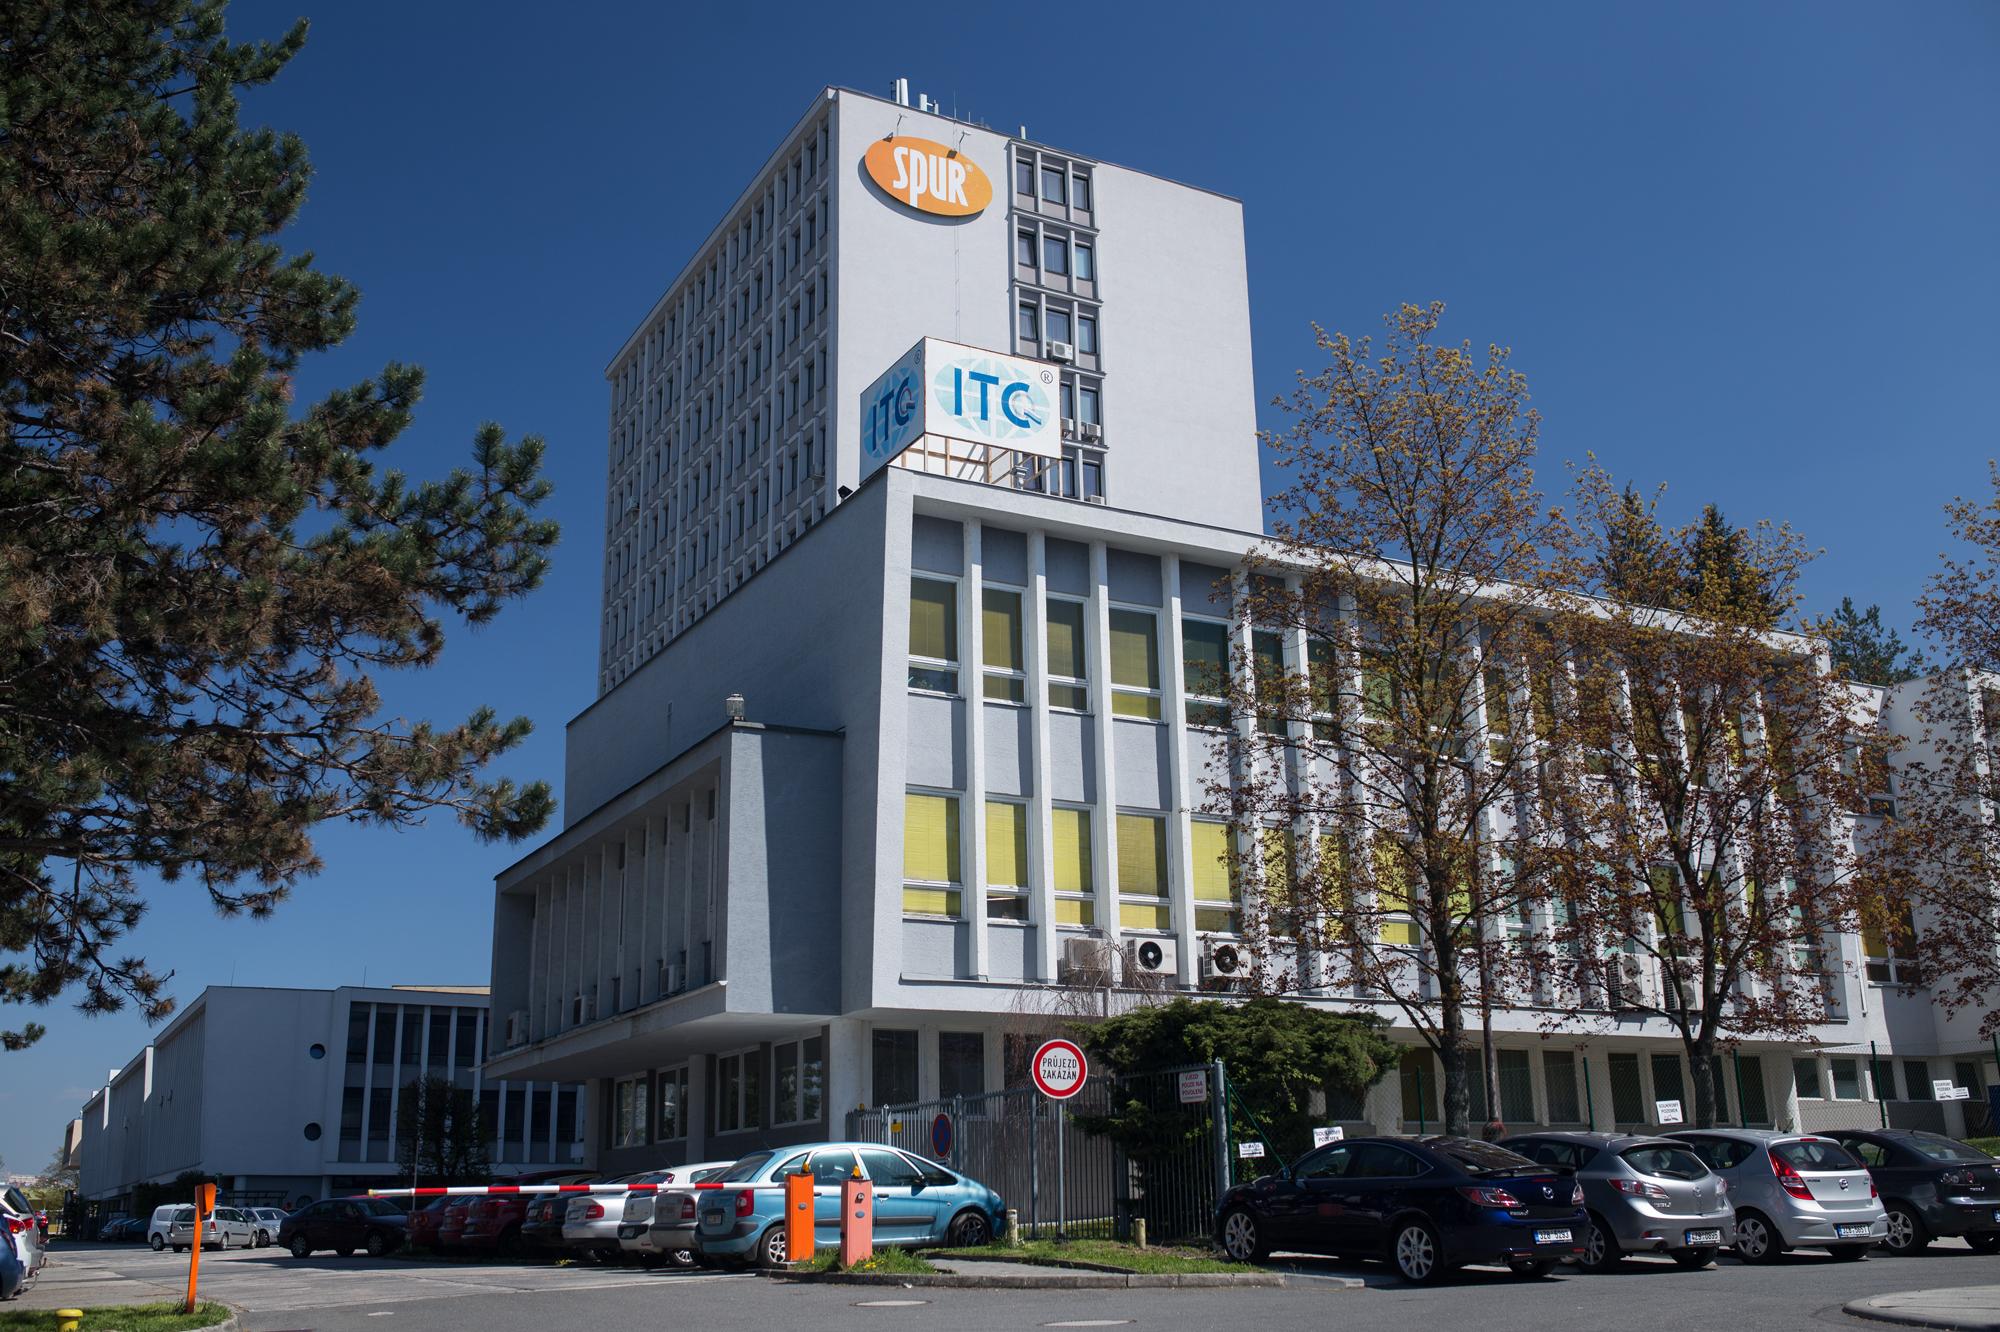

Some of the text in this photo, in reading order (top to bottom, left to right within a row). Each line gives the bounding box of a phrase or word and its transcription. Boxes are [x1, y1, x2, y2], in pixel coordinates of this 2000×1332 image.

[871, 376, 916, 452] ITC
[954, 367, 1042, 429] ITC
[1042, 1055, 1077, 1069] PRŮJEZD
[1042, 1067, 1077, 1080] ZAKÁZÁN
